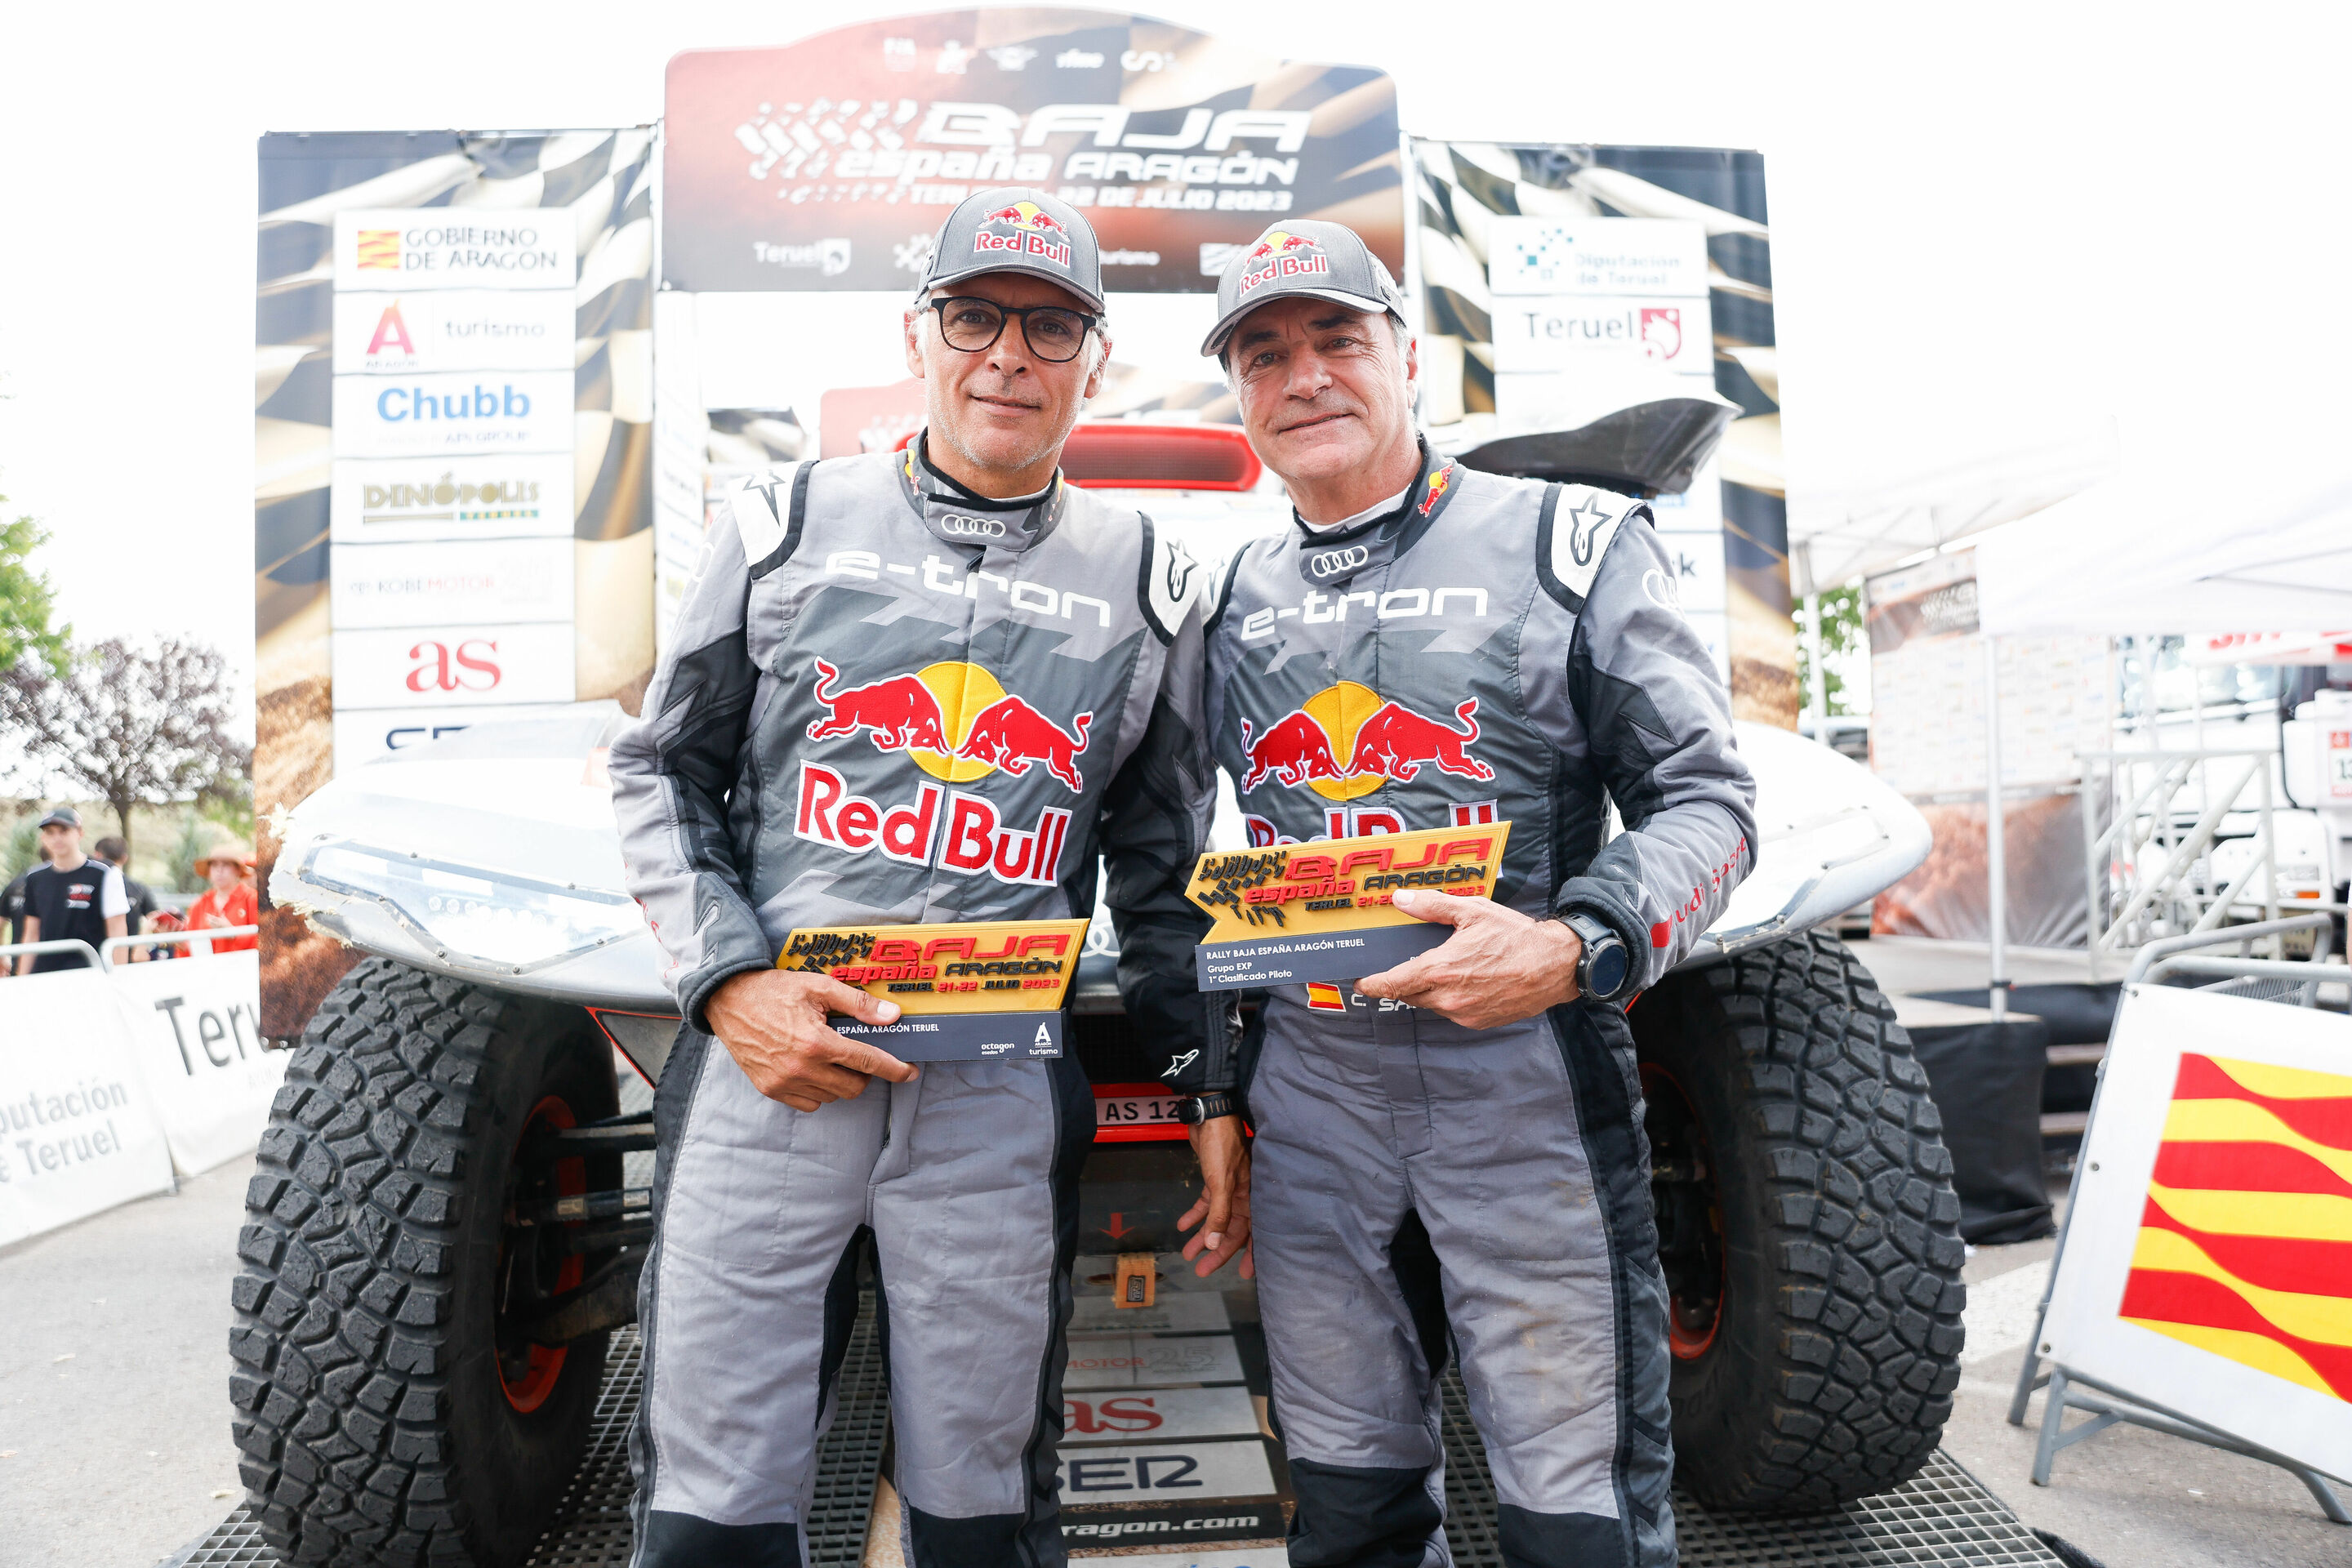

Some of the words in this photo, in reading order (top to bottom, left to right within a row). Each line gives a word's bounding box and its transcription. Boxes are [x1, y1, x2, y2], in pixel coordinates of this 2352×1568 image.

[915, 101, 1314, 153] BAJA
[833, 144, 1053, 185] españa
[1064, 150, 1299, 185] ARAGÓN
[1215, 189, 1294, 211] 2023
[406, 226, 538, 247] GOBIERNO
[975, 230, 1023, 252] Red
[1027, 233, 1071, 268] Bull
[406, 252, 437, 270] DE
[1240, 259, 1277, 297] Red
[1280, 254, 1329, 278] Bull
[445, 318, 546, 338] turismo
[1521, 310, 1635, 341] Teruel
[376, 384, 532, 423] Chubb
[363, 470, 541, 510] DINÓPOLIS
[825, 550, 1111, 627] e-tron
[1241, 587, 1489, 640] e-tron
[406, 639, 501, 692] as
[793, 760, 946, 866] Red
[938, 790, 1072, 887] Bull
[1285, 838, 1493, 880] BAJA
[1245, 876, 1356, 905] españa
[1363, 863, 1486, 891] ARAGÓN
[1305, 898, 1353, 911] TERUEL
[1356, 894, 1392, 907] 21-2
[1674, 882, 1706, 926] udi
[870, 934, 1071, 961] BAJA
[1206, 950, 1232, 960] RALLY
[1233, 948, 1256, 958] BAJA
[1258, 944, 1293, 956] ESPAÑA
[1294, 941, 1334, 953] ARAGÓN
[1336, 938, 1365, 948] TERUEL
[830, 960, 938, 985] españa
[945, 957, 1062, 977] ARAGÓN
[1207, 964, 1235, 974] Grupo
[1236, 962, 1253, 971] EXP
[1218, 972, 1267, 982] Clasificado
[1268, 969, 1293, 979] Piloto
[887, 982, 934, 992] TERUEL
[981, 979, 1019, 991] JULIO
[1022, 978, 1060, 990] 2023
[1351, 993, 1367, 1007] C.
[837, 1024, 870, 1035] ESPAÑA
[871, 1022, 910, 1034] ARAGÓN
[912, 1022, 939, 1032] TERUEL
[981, 1043, 1015, 1054] octagon
[1105, 1102, 1139, 1121] AS
[16, 1117, 122, 1176] Teruel
[1058, 1454, 1204, 1492] ER
